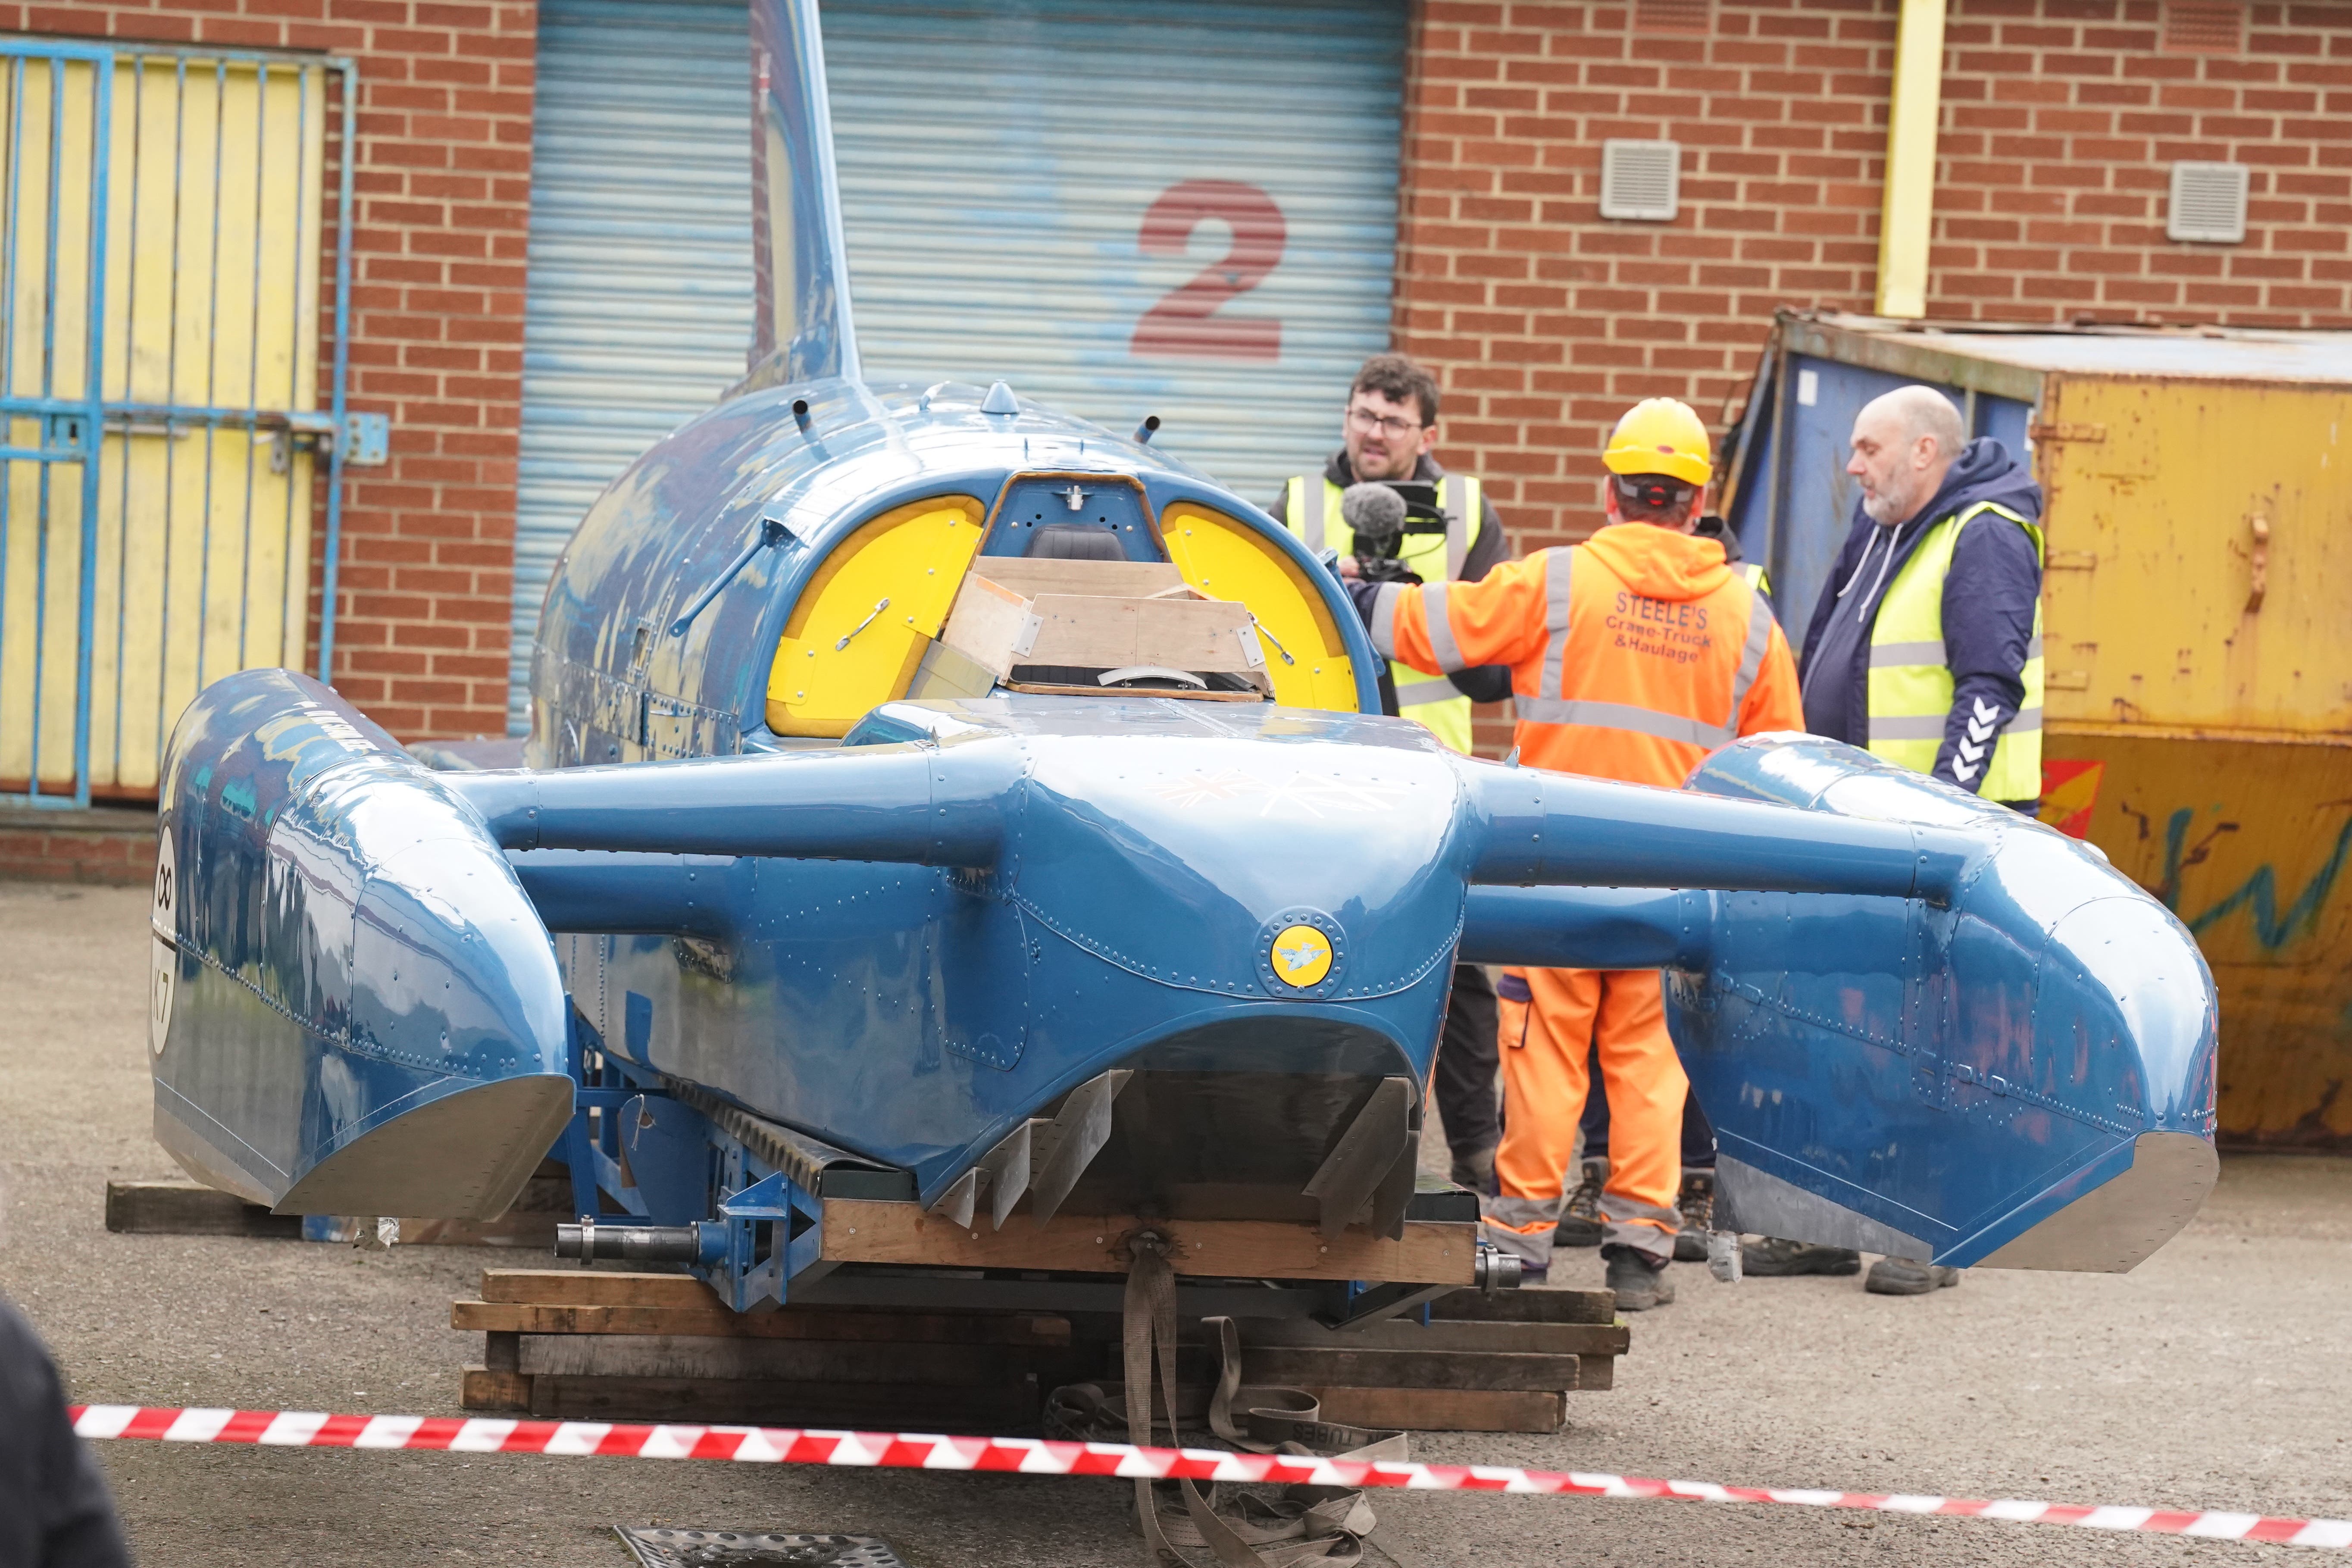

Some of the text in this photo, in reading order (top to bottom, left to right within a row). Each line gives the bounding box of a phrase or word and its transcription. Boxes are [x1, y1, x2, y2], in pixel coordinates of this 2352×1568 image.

[1129, 178, 1287, 363] 2
[1616, 592, 1708, 629] STEELE'S
[153, 967, 169, 1023] K7
